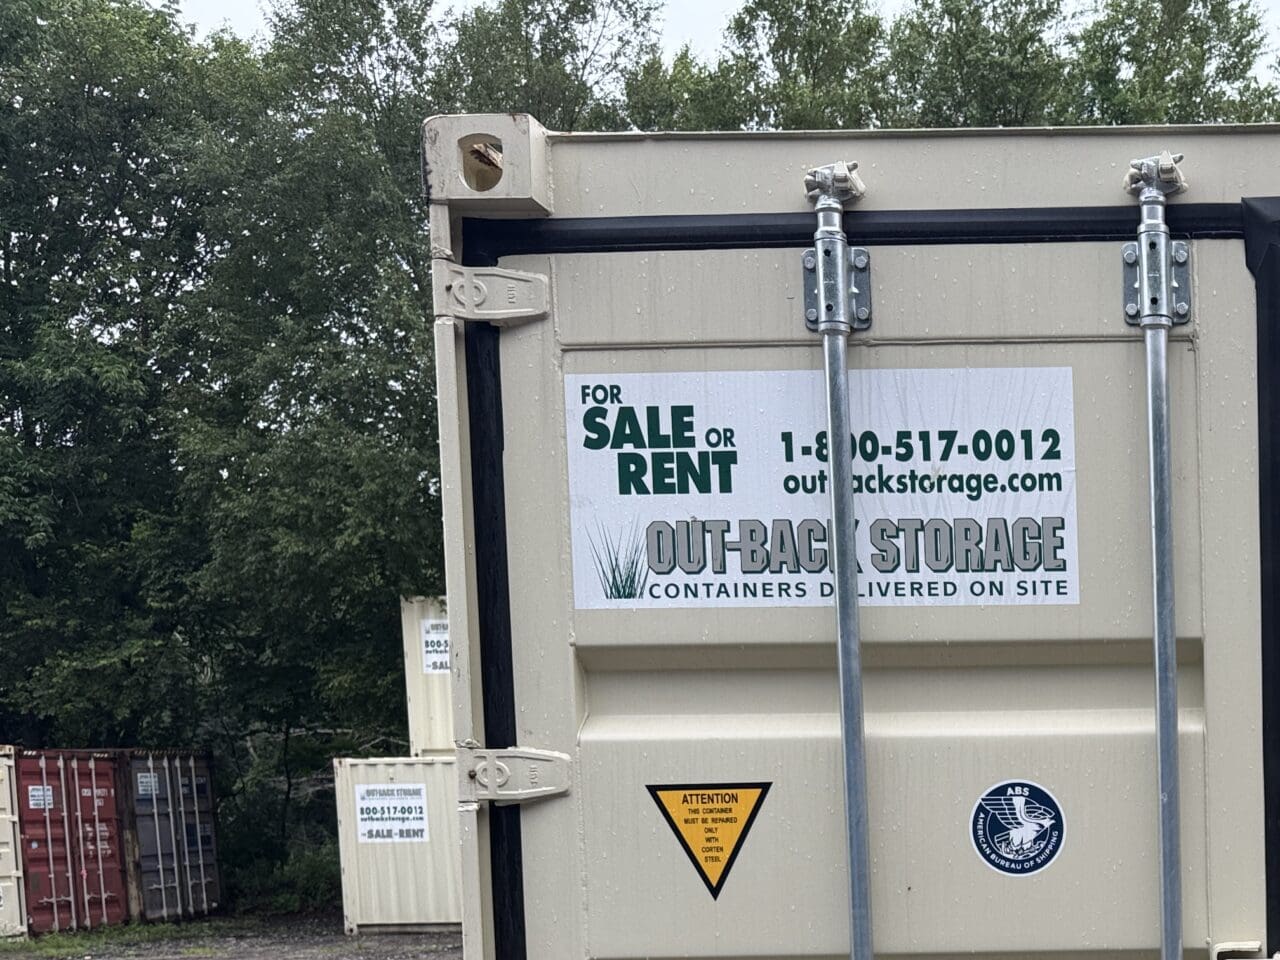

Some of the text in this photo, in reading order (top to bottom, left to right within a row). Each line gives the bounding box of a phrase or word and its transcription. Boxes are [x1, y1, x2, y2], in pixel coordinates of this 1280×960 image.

[581, 384, 623, 404] FOR
[582, 404, 736, 450] SALE OR
[617, 450, 738, 496] RENT
[783, 463, 1063, 501] outackstorage.com
[870, 516, 1067, 573] STORAGE
[648, 579, 1068, 599] CONTAINERS DIVERED ON SITE
[432, 661, 450, 670] SAL
[682, 793, 739, 805] ATTENTION
[1007, 786, 1029, 796] ABS
[360, 806, 424, 815] 800-517-0012
[976, 812, 1059, 869] AMERICAN BUREAU OF SHIPPING
